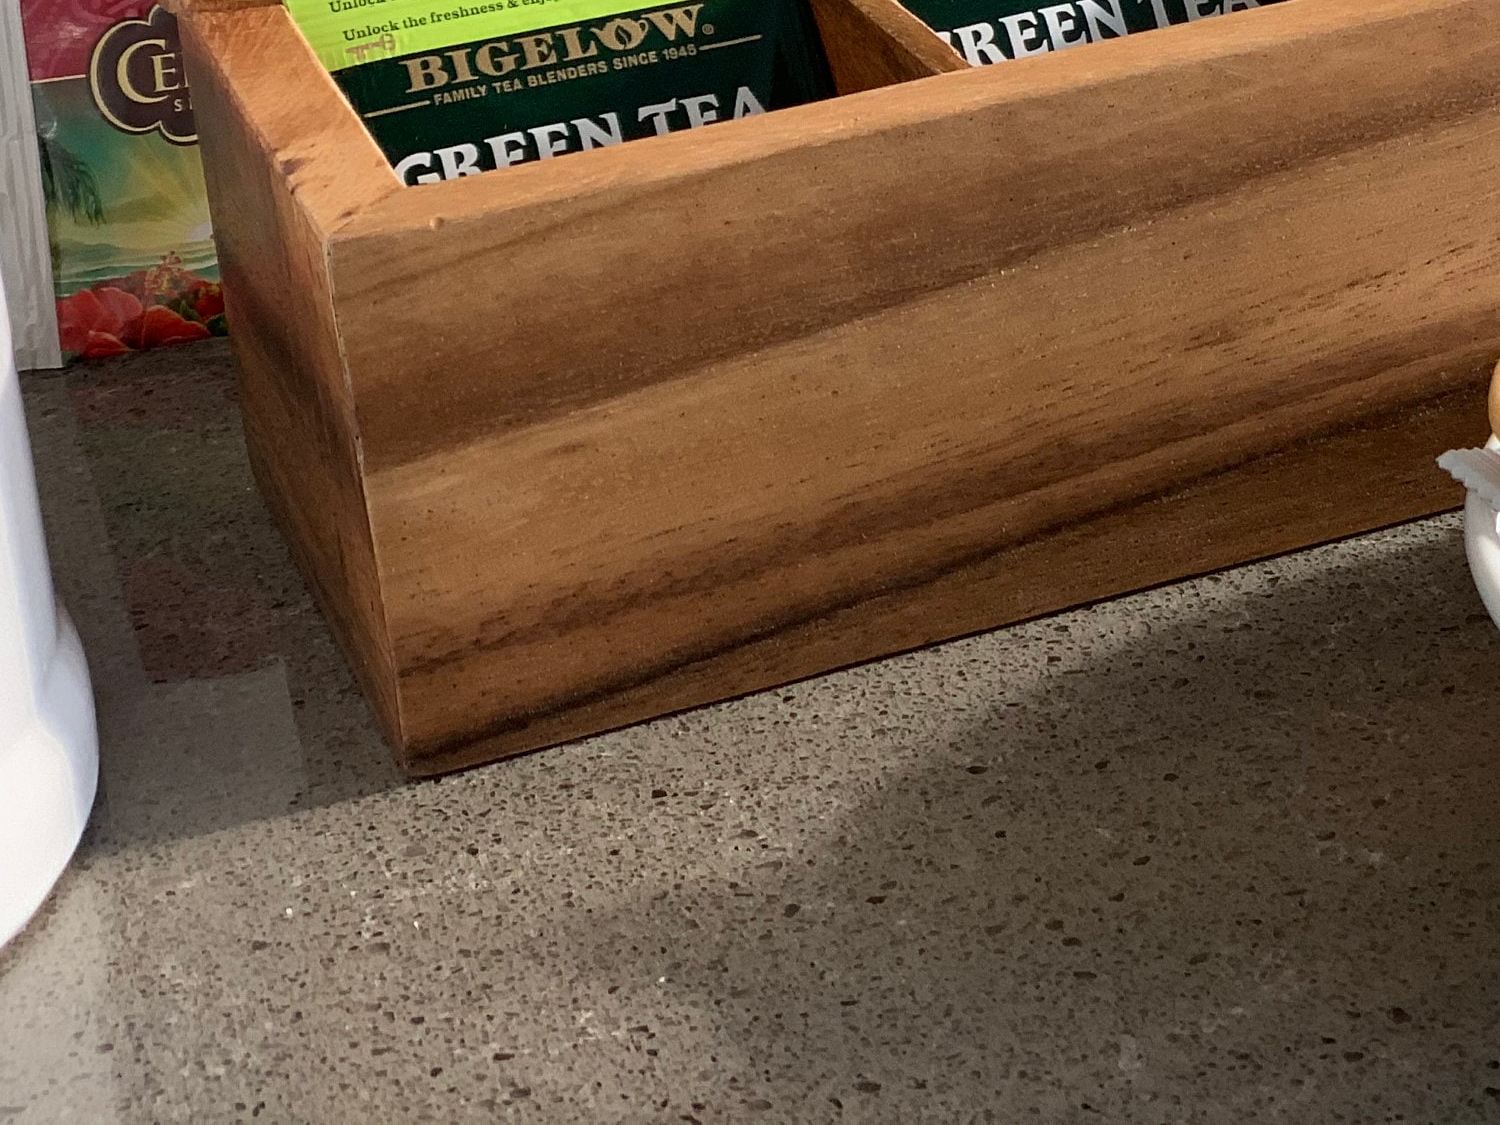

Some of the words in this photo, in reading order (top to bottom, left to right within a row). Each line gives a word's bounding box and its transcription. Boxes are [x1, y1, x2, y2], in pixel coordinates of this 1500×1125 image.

[342, 21, 400, 41] Unlock
[403, 15, 427, 29] the
[430, 1, 503, 24] freshness
[399, 3, 704, 93] BIGELOW
[434, 84, 488, 106] FAMILY
[491, 78, 523, 94] TEA
[527, 60, 607, 88] BLENDERS
[613, 50, 658, 70] SINCE
[662, 43, 698, 61] 1945
